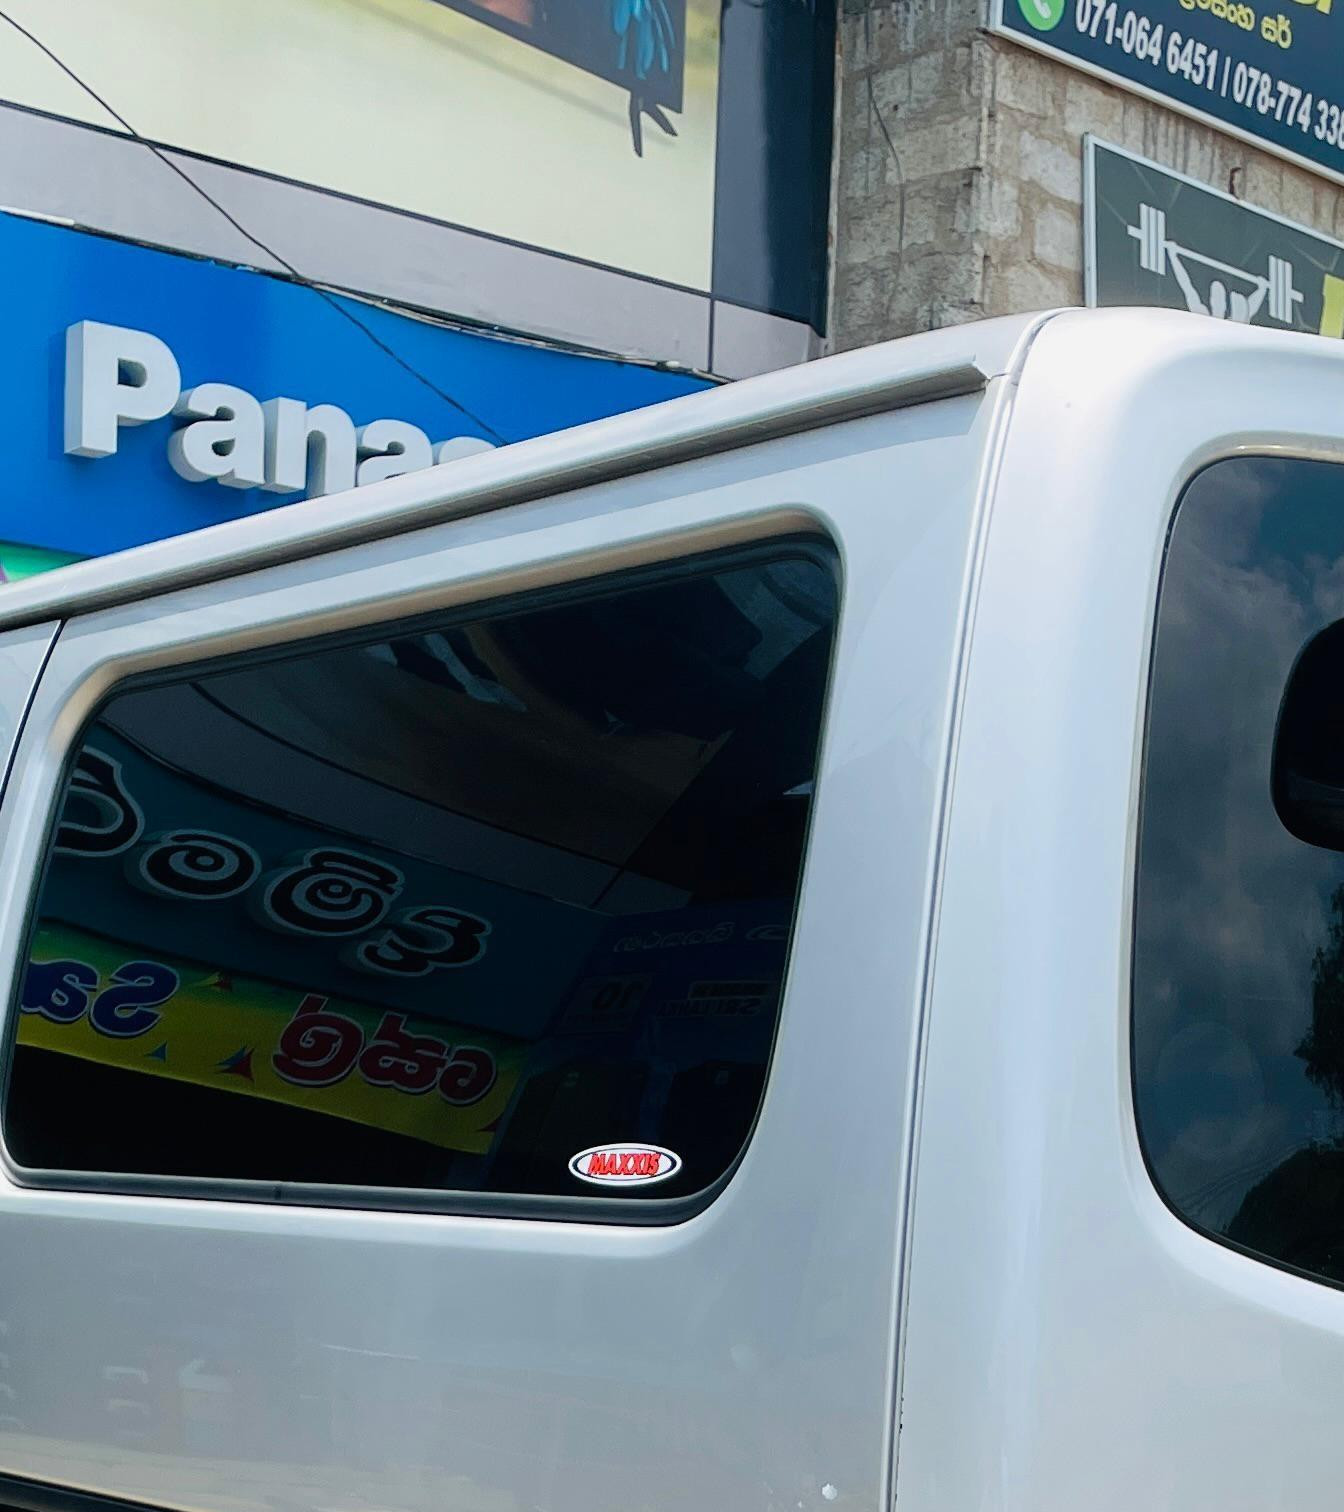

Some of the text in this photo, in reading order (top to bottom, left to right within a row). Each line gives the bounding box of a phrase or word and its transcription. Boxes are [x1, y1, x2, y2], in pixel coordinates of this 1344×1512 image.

[1075, 0, 1163, 66] 071-064
[1166, 32, 1220, 92] 6451
[1232, 62, 1312, 134] 078-774
[64, 318, 504, 498] Pana
[587, 1152, 662, 1176] MAXXIS
